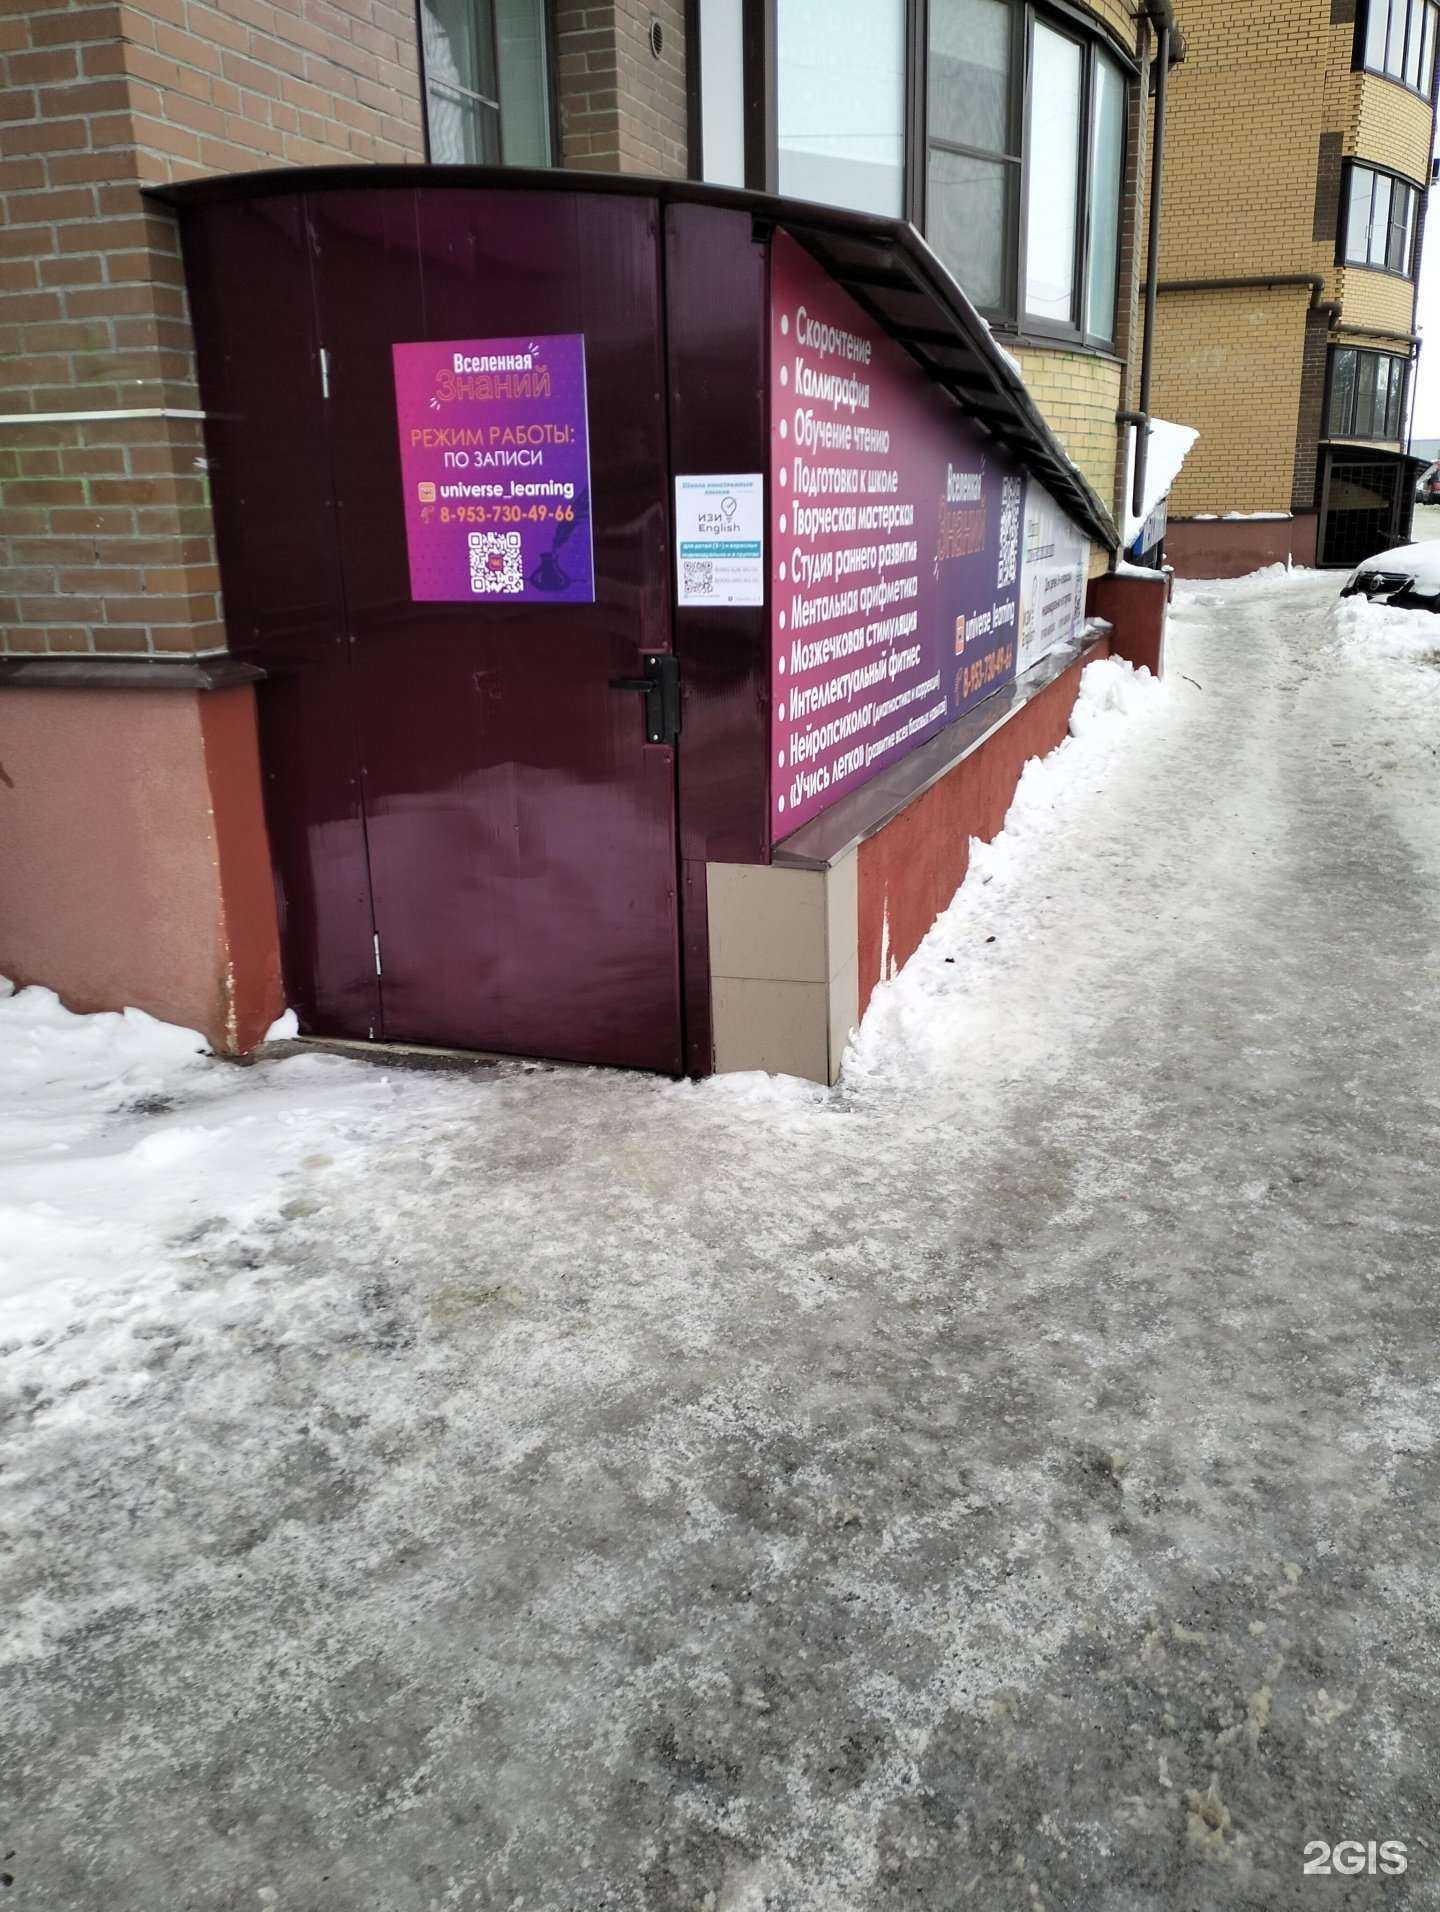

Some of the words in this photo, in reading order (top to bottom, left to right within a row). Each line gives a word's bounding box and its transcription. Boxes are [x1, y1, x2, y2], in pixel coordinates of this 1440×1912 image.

[796, 305, 872, 366] Скорочтение
[435, 365, 551, 401] Знаний
[453, 352, 532, 373] Вселенная
[795, 357, 870, 413] Каллиграфия
[410, 428, 483, 448] РЕЖИМ
[489, 423, 576, 445] РАБОТЫ:
[794, 408, 852, 455] Обучение
[853, 428, 889, 454] чтению
[444, 450, 469, 468] ПО
[474, 449, 544, 468] ЗАПИСИ
[793, 457, 858, 497] Подготовка
[859, 474, 866, 492] к
[867, 470, 898, 494] школе
[440, 479, 574, 500] universe_learning
[946, 462, 982, 502] Вселенная
[440, 504, 574, 523] 8-953-730-49-66
[698, 522, 741, 535] English
[792, 500, 857, 543] Творческая
[857, 504, 914, 537] мастерская
[791, 547, 833, 589] Студия
[835, 545, 877, 577] раннего
[878, 541, 917, 573] развития
[791, 589, 858, 630] Ментальная
[859, 575, 918, 617] арифметика
[965, 599, 1016, 643] universe_learning
[790, 630, 864, 676] Мозжечковая
[866, 609, 918, 648] стимуляция
[789, 653, 887, 722] Интеллектуальный
[888, 643, 921, 683] фитнес
[789, 701, 872, 767] Нейропсихолог
[789, 765, 830, 809] «Учись
[831, 747, 864, 785] легко»
